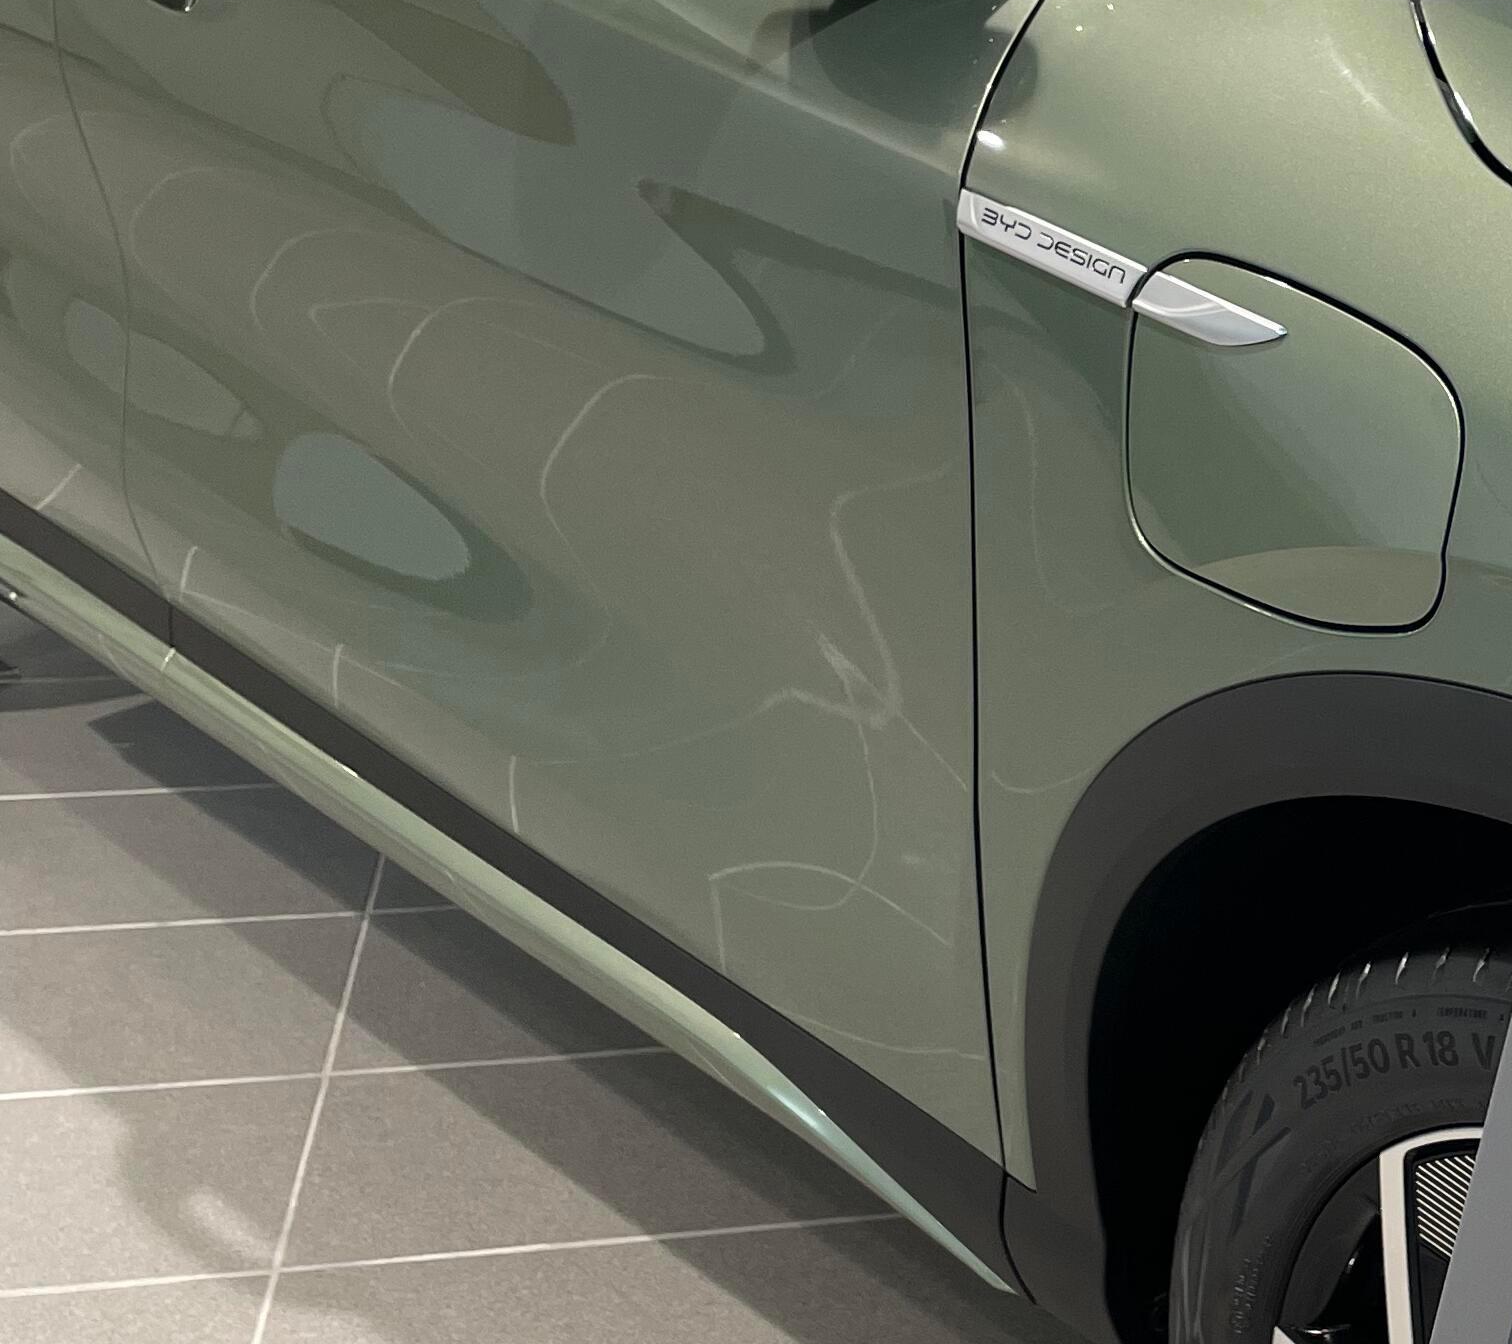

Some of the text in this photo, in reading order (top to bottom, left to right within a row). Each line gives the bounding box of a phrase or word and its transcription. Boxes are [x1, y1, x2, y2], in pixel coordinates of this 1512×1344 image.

[981, 207, 1127, 285] BYD DESIGN
[1292, 1037, 1391, 1111] 235/50
[1471, 1031, 1497, 1071] V
